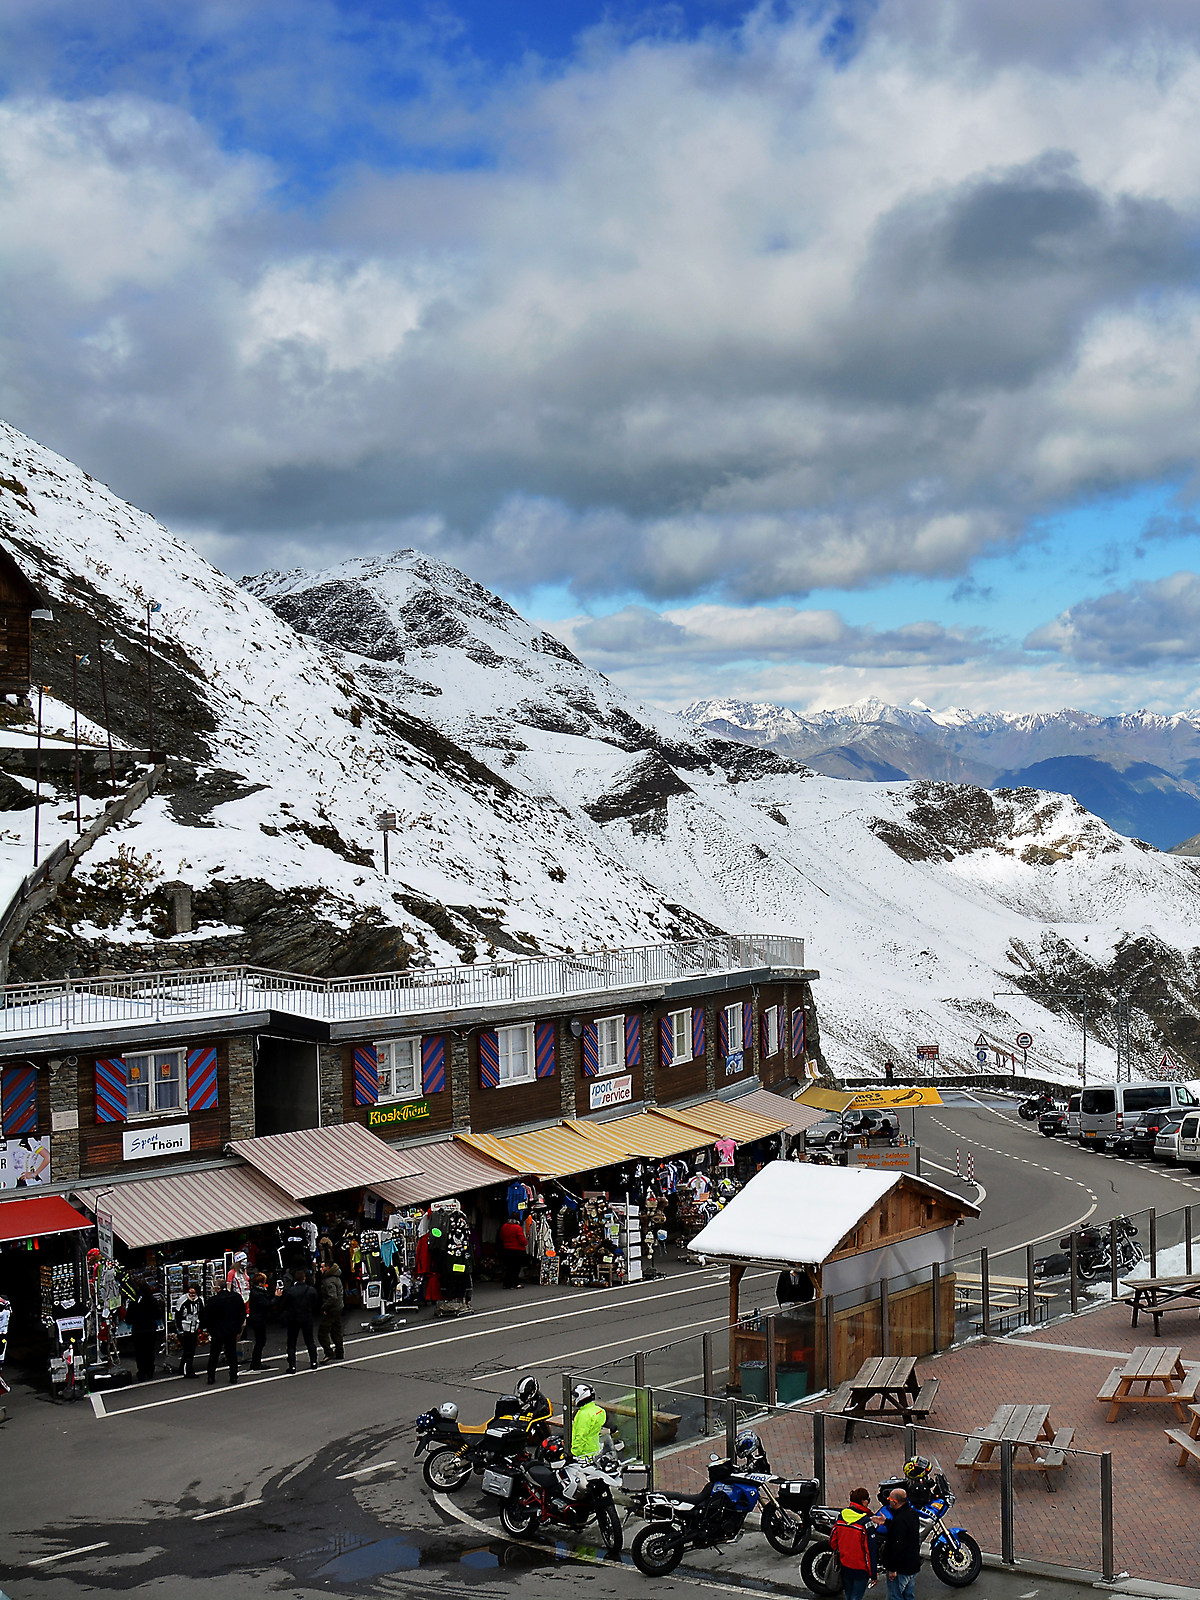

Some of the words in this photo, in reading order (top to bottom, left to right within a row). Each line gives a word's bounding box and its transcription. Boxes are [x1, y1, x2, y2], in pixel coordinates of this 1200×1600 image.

[591, 1081, 612, 1096] sport
[602, 1087, 631, 1104] service
[130, 1133, 158, 1152] Sport
[150, 1137, 183, 1150] Thöni
